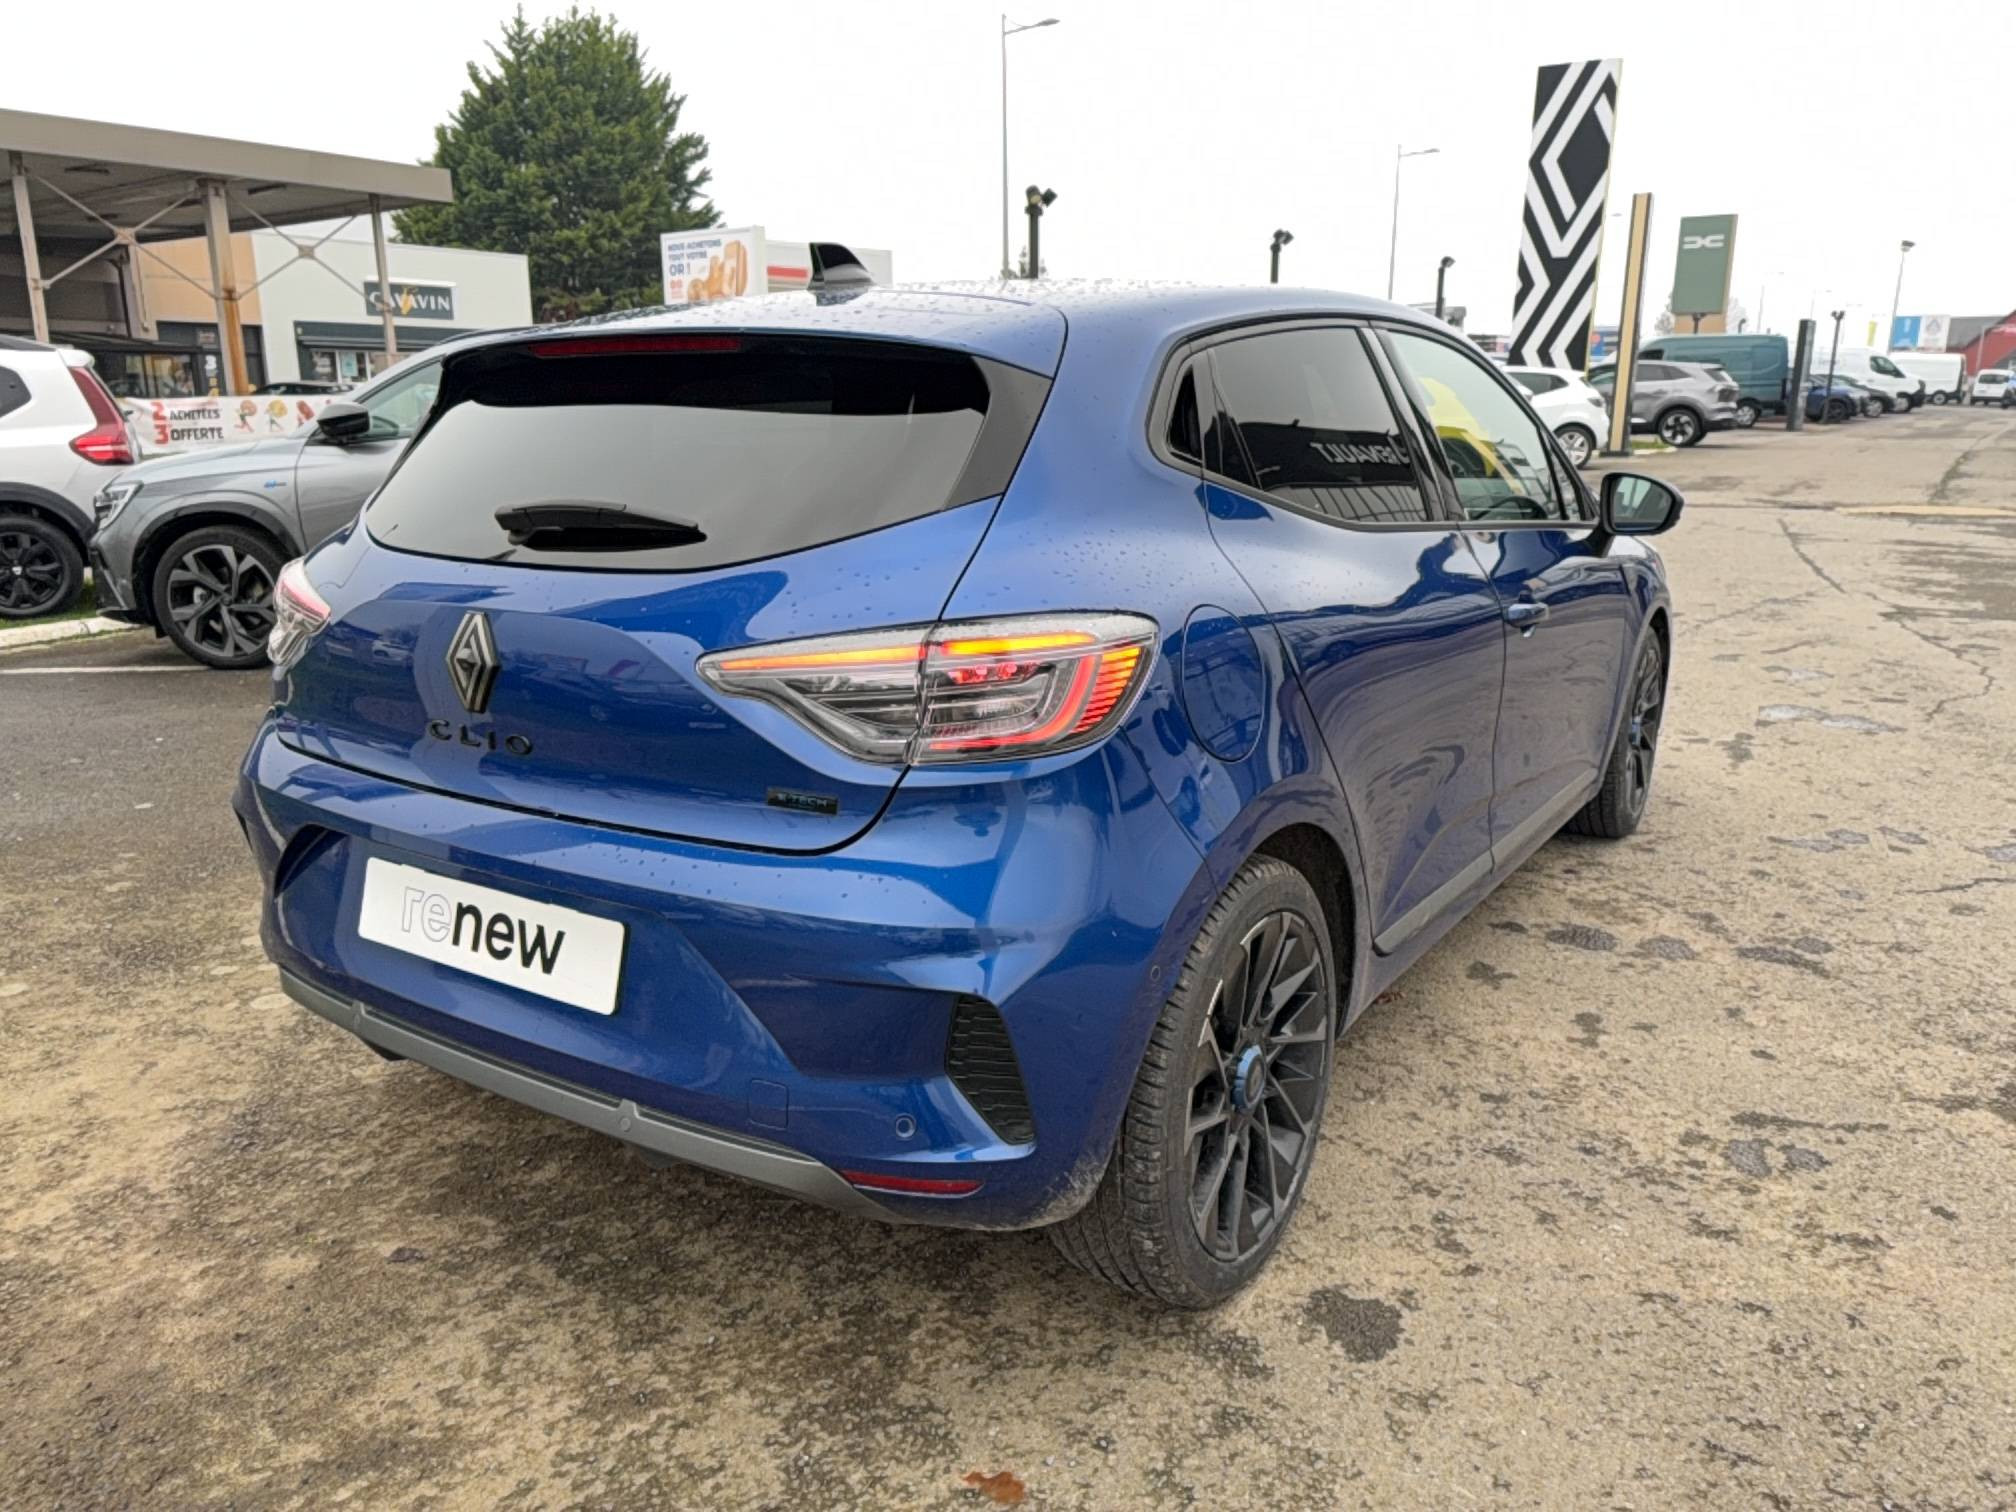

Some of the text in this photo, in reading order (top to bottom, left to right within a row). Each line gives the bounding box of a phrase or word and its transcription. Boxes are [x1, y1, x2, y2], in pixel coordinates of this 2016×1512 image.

[669, 263, 684, 276] OR
[170, 427, 224, 441] OFFERTE
[429, 719, 533, 755] CLIO
[400, 886, 566, 975] renew
